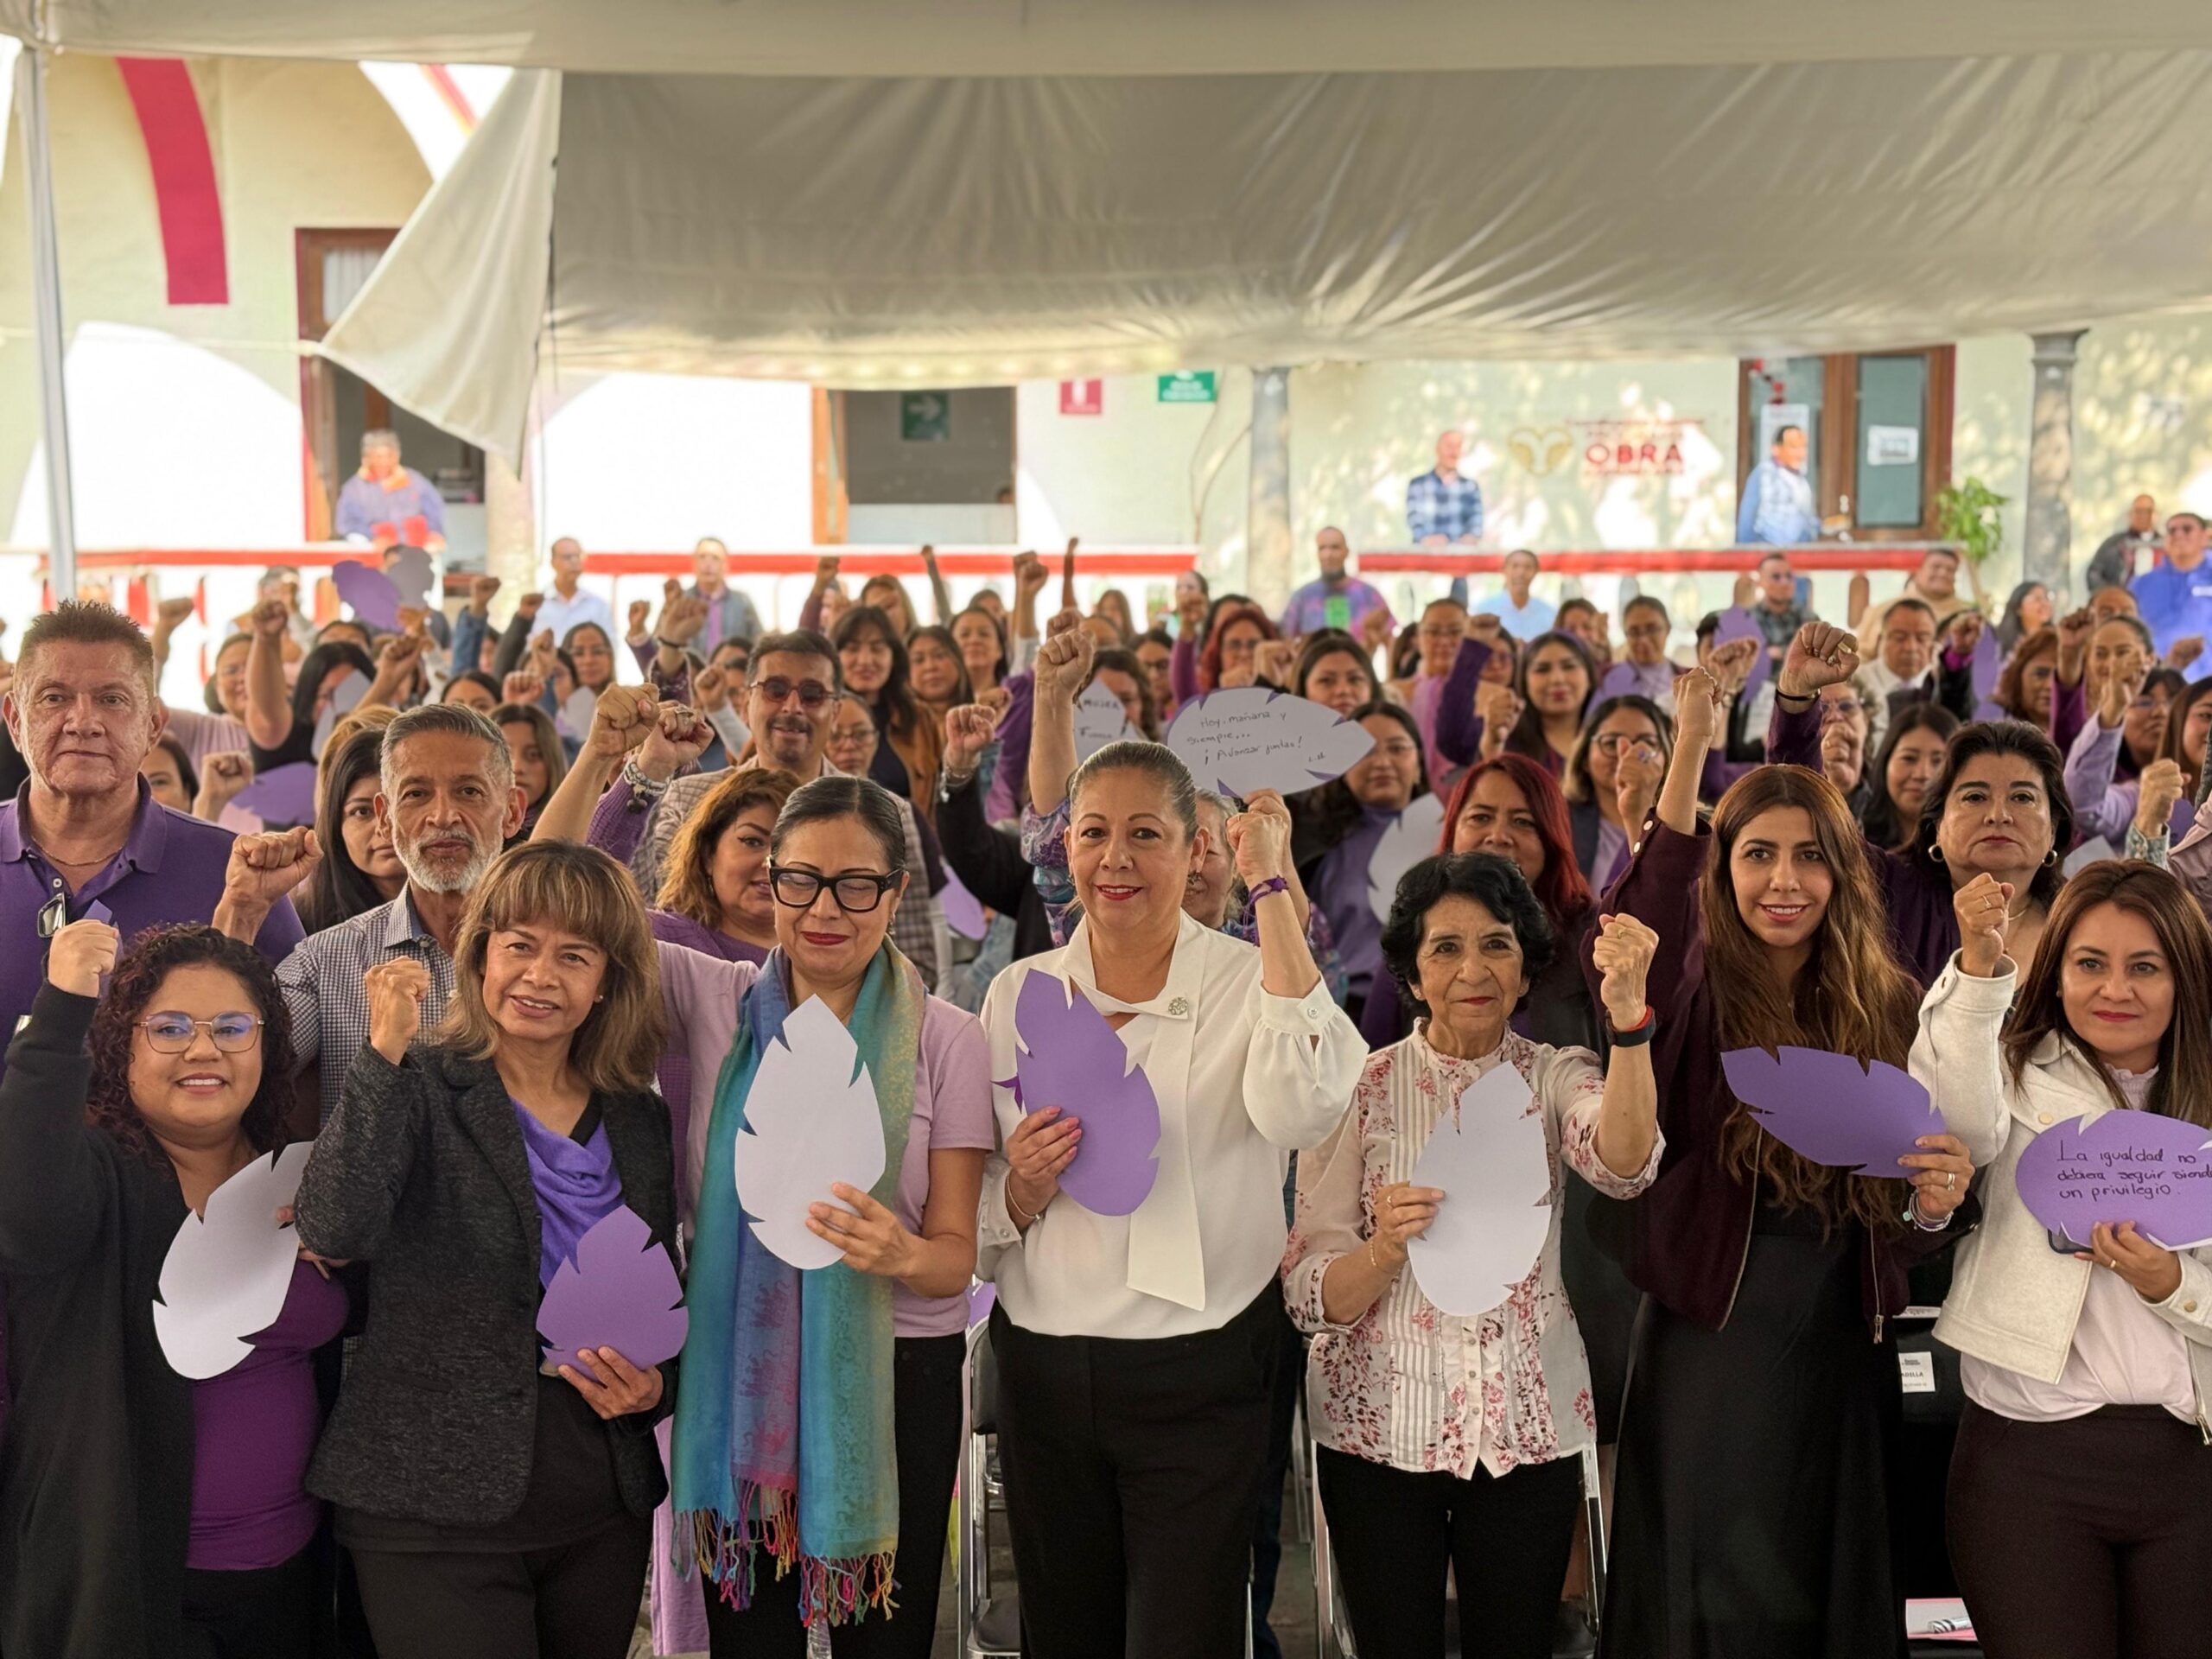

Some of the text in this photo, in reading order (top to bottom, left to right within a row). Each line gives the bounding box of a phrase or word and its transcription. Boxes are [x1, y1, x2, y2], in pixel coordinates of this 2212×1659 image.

[1586, 443, 1682, 463] OBRA
[1228, 710, 1271, 723] mañana
[2056, 1139, 2197, 1168] La igualdad no
[2117, 1169, 2167, 1185] seguir
[2058, 1188, 2083, 1199] un
